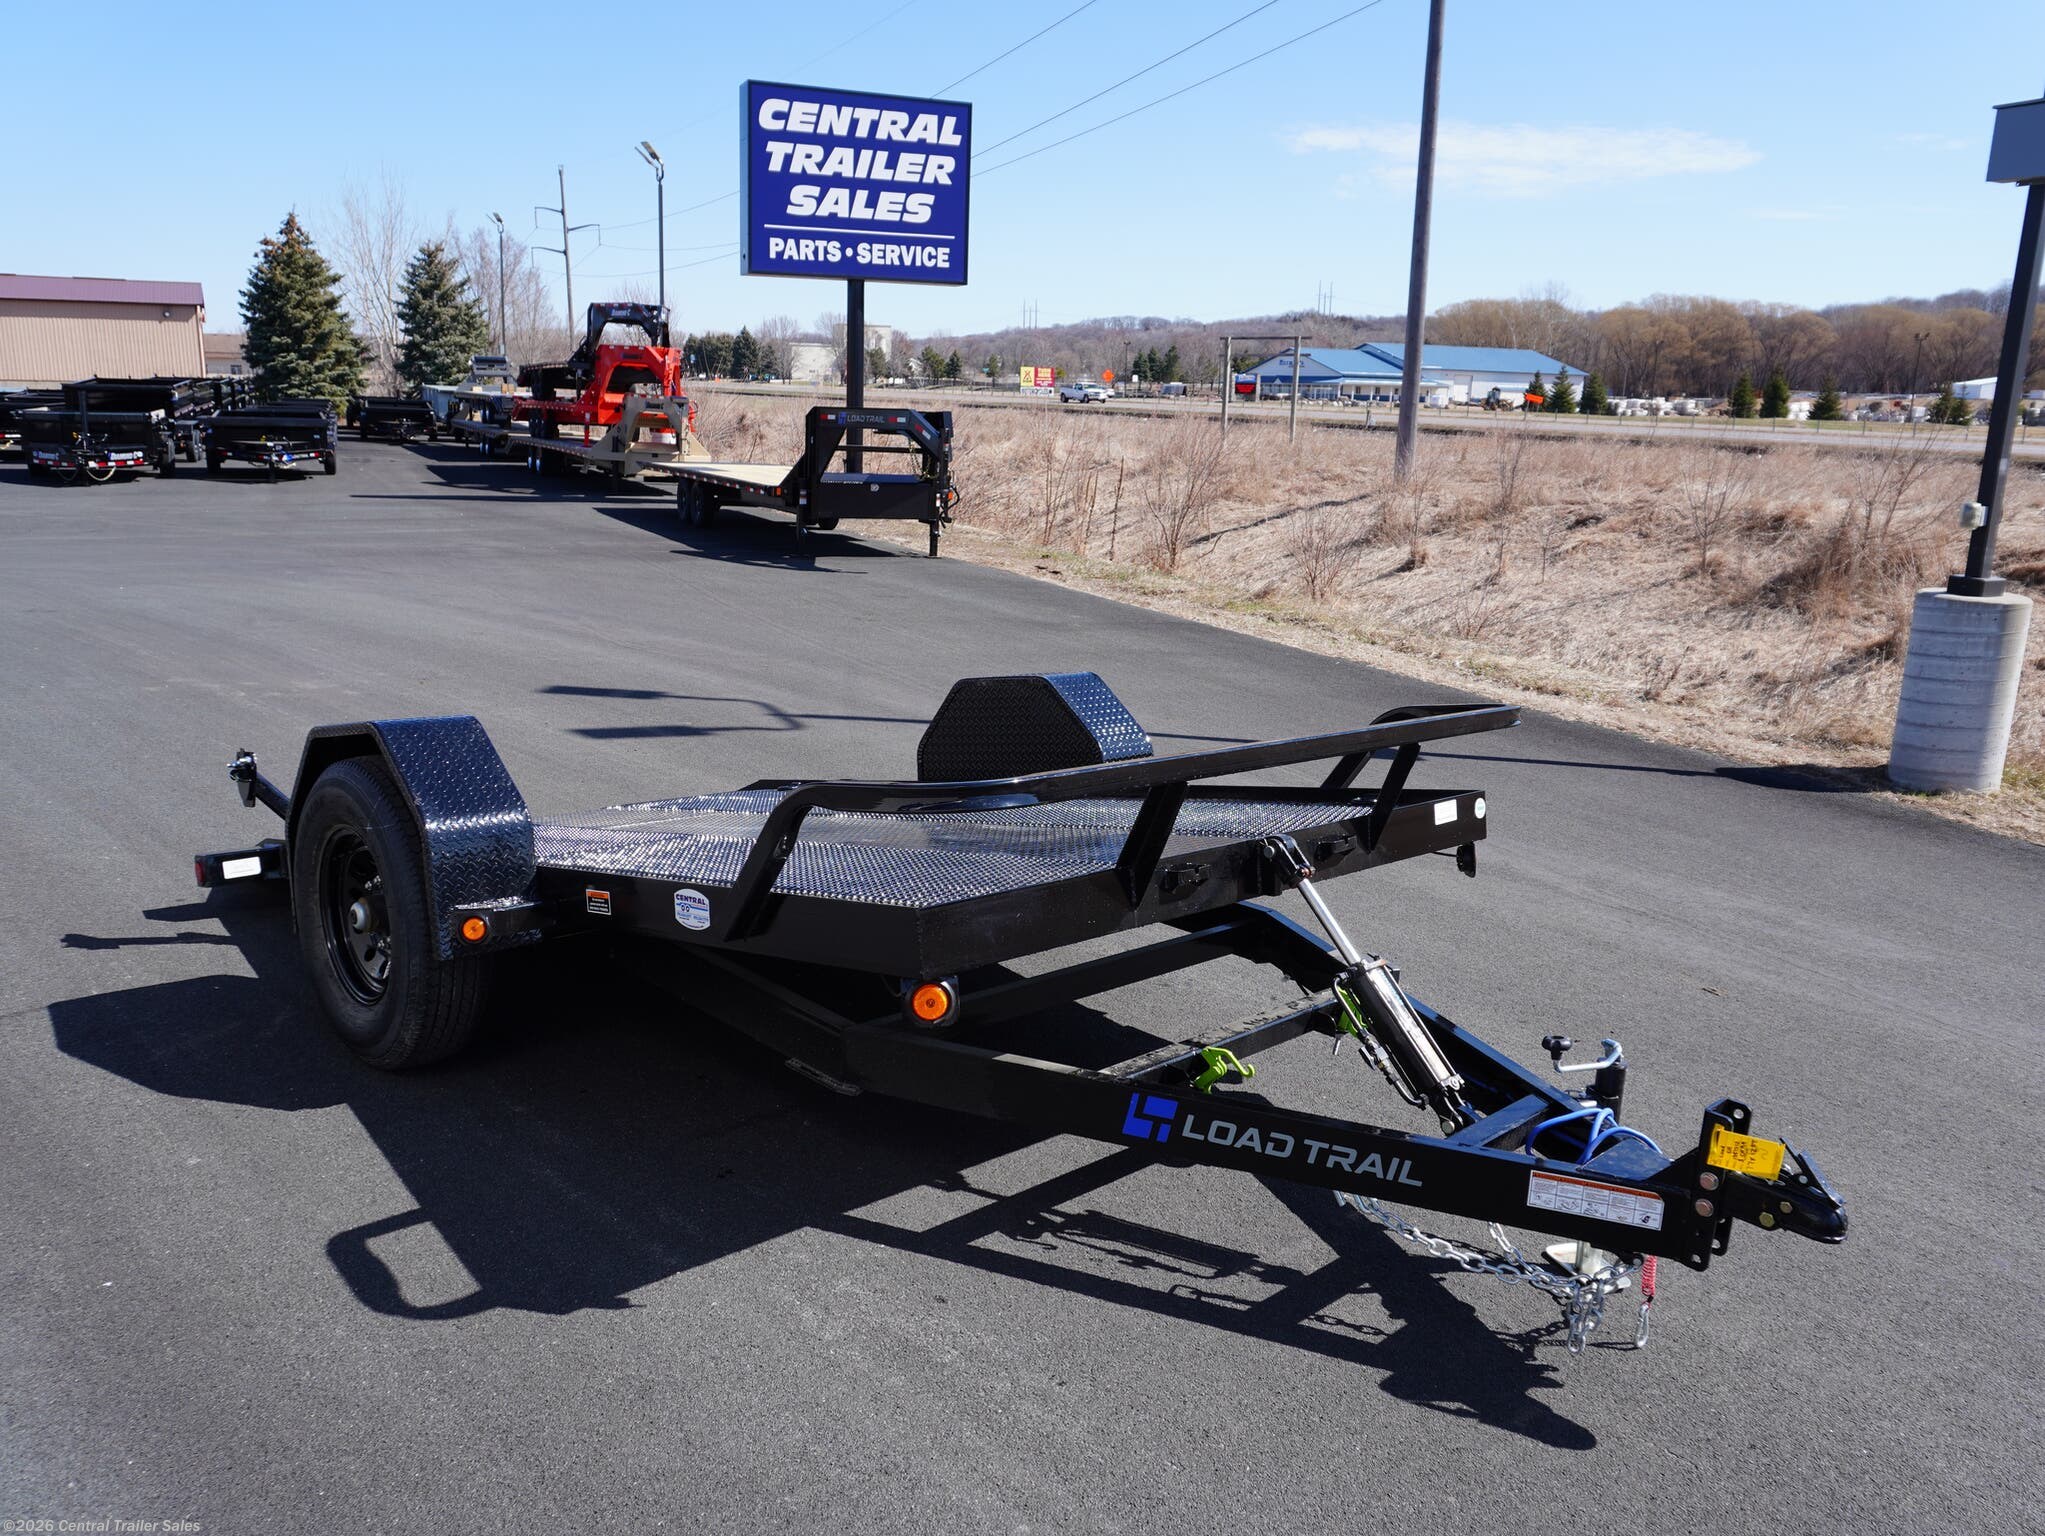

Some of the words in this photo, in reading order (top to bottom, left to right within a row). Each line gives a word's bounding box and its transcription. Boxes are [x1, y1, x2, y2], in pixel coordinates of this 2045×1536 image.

[758, 98, 962, 146] CENTRAL
[765, 140, 956, 185] TRAILER
[786, 184, 935, 224] SALES
[769, 237, 842, 263] PARTS
[856, 242, 950, 268] SERVICE
[847, 415, 866, 423] LOAD
[866, 415, 886, 423] TRAIL
[676, 893, 706, 905] CENTRAL
[1181, 1114, 1296, 1158] LOAD
[1303, 1138, 1423, 1187] TRAIL
